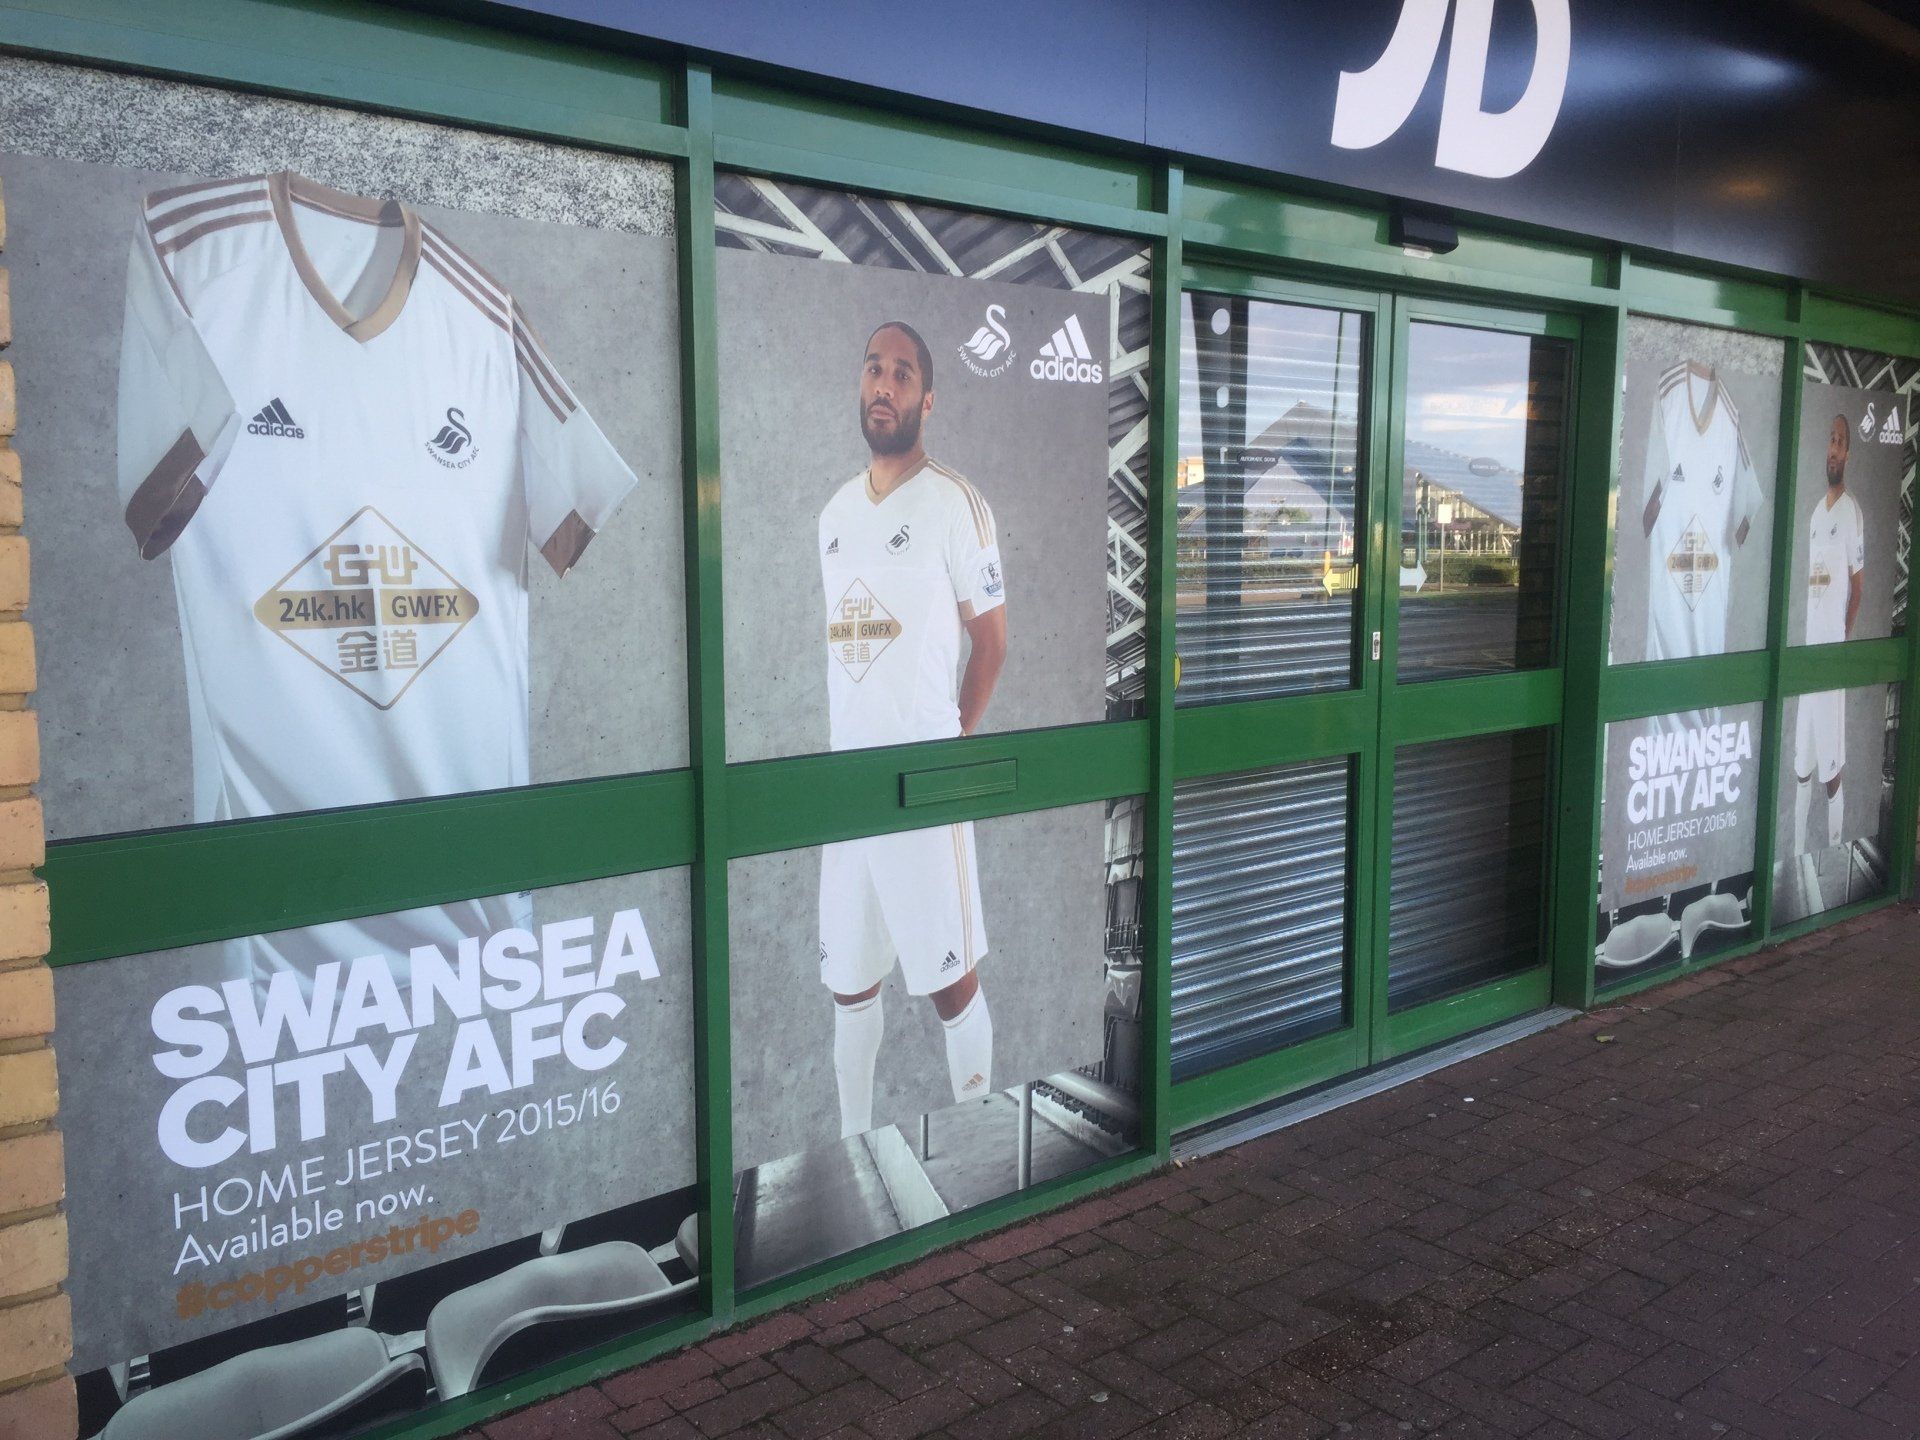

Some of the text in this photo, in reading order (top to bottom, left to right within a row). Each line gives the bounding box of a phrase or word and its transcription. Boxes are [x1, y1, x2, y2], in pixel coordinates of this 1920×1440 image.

[1331, 0, 1571, 178] JD
[957, 345, 1017, 378] SWANSEA CITY AFC
[1030, 355, 1103, 384] adidas
[247, 421, 305, 439] adidas
[424, 441, 456, 469] SWANSEA
[457, 458, 472, 469] CITY
[279, 595, 460, 622] 24k.hk GWFX
[861, 623, 892, 637] GWFX
[336, 630, 419, 673] 金道
[1629, 721, 1751, 780] SWANSEA
[1627, 763, 1741, 824] CITY AFC
[1627, 810, 1737, 852] HOME JERSEY 2015/16
[1625, 847, 1688, 873] Available now.
[150, 908, 660, 1079] SWANSEA
[158, 991, 628, 1168] CITY AFC
[173, 1081, 622, 1230] HOME JERSEY 2015/16
[172, 1185, 434, 1275] Available now.
[176, 1208, 480, 1320] #copperstripe
